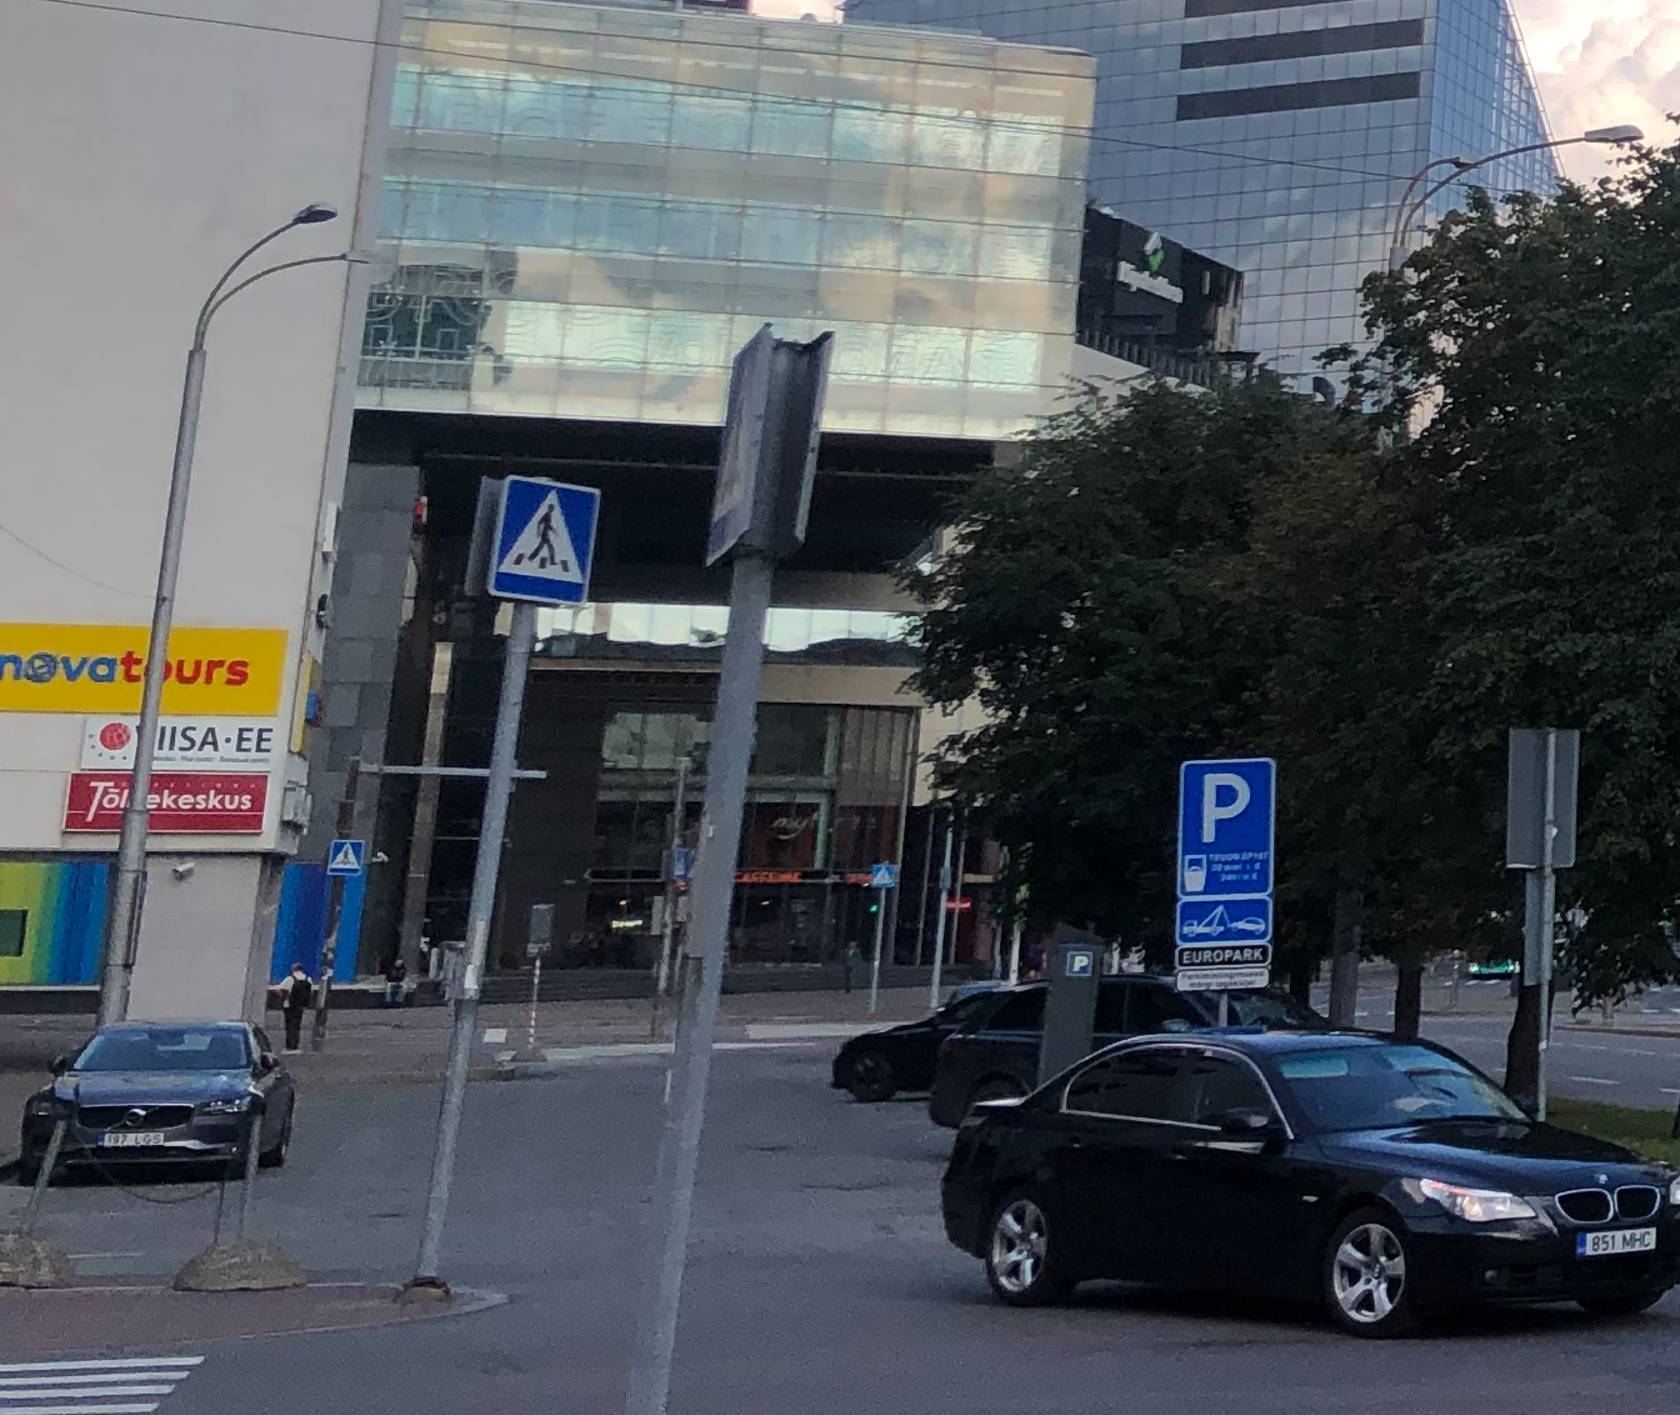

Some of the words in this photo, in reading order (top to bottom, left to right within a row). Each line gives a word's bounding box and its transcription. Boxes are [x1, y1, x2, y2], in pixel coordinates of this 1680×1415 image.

[0, 651, 250, 686] novaturs
[84, 781, 252, 823] Tõlekeskus
[1202, 773, 1250, 843] P
[1073, 956, 1089, 972] P
[1183, 948, 1264, 964] EUROPARK
[1591, 1235, 1615, 1252] 851
[1622, 1230, 1651, 1249] MHC
